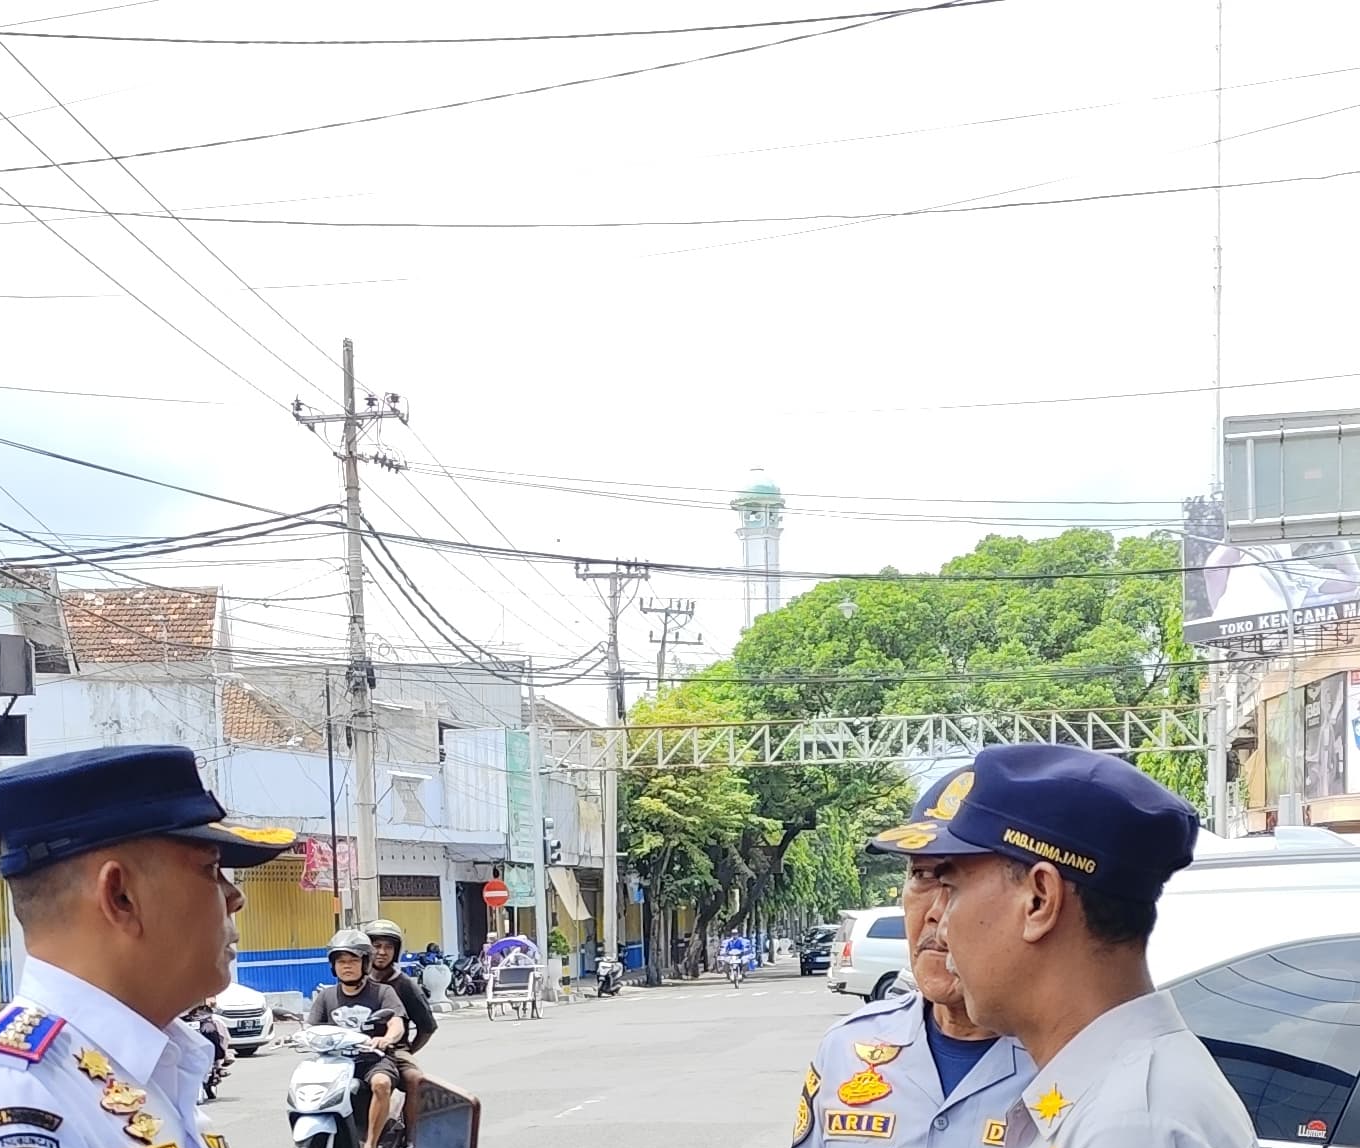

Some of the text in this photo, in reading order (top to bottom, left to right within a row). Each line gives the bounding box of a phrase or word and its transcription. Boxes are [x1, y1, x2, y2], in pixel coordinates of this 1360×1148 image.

[1219, 619, 1253, 636] TOKO
[831, 1113, 886, 1132] ARIE
[990, 1123, 1004, 1141] D
